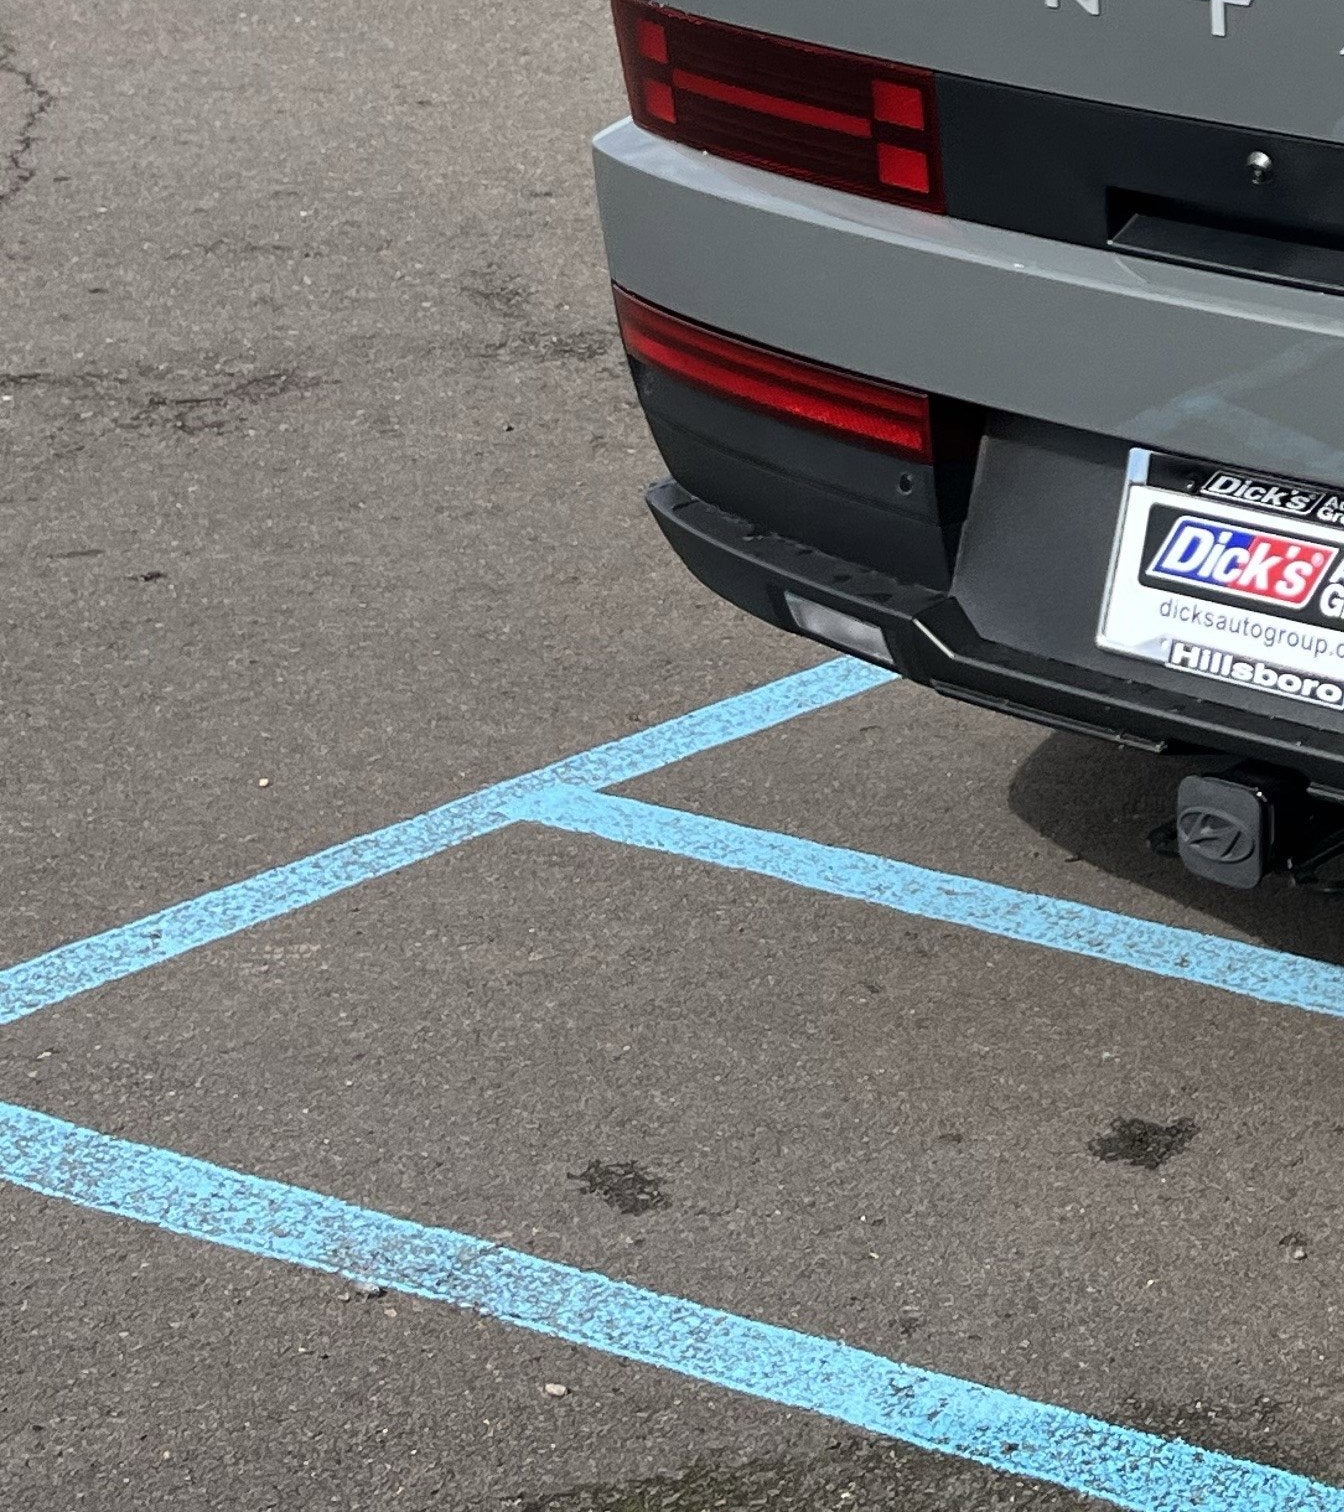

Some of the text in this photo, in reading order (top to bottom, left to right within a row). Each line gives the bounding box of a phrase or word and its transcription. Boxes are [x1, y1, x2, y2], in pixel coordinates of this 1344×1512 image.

[1208, 475, 1312, 511] Dick's
[1160, 525, 1314, 598] Dick's
[1170, 642, 1344, 704] Hillsboro
